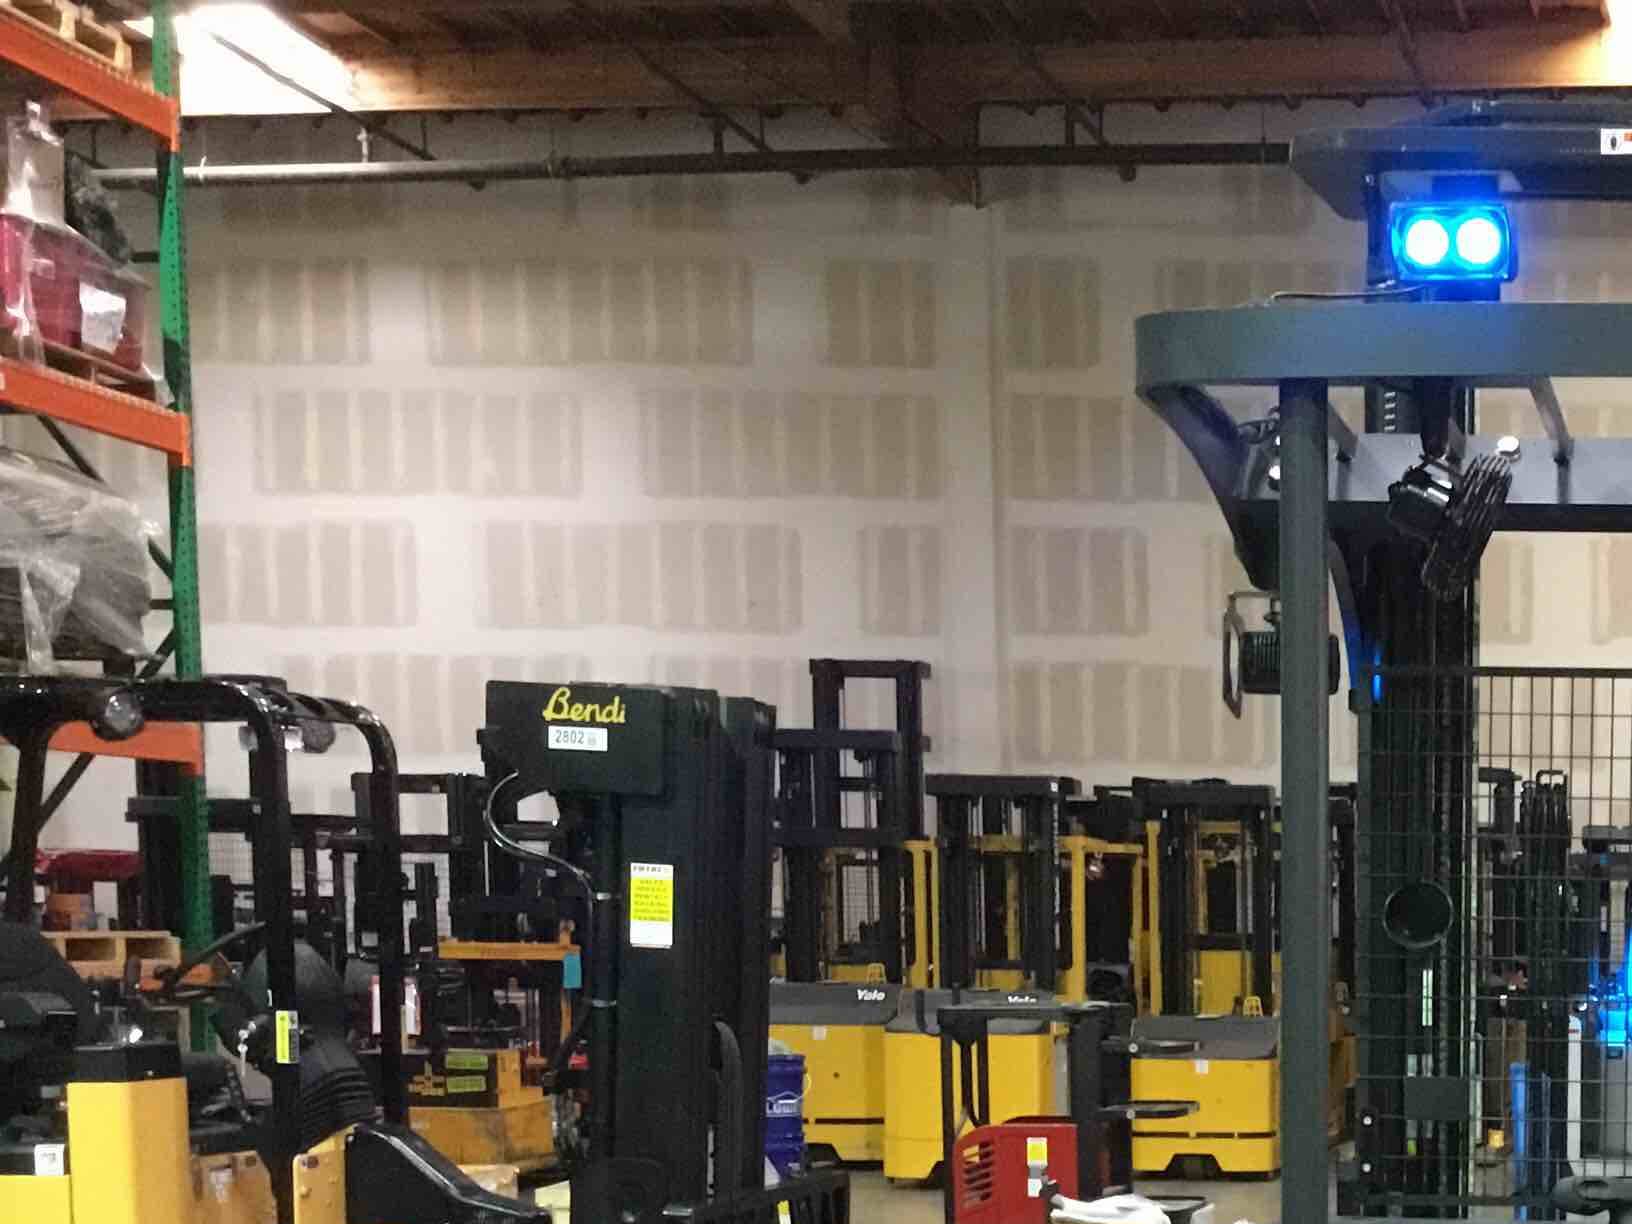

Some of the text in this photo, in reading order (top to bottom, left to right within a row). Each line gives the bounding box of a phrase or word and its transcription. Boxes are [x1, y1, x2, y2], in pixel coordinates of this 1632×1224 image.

[542, 686, 626, 724] Bendi
[555, 729, 585, 744] 2802
[856, 988, 886, 1001] Yale
